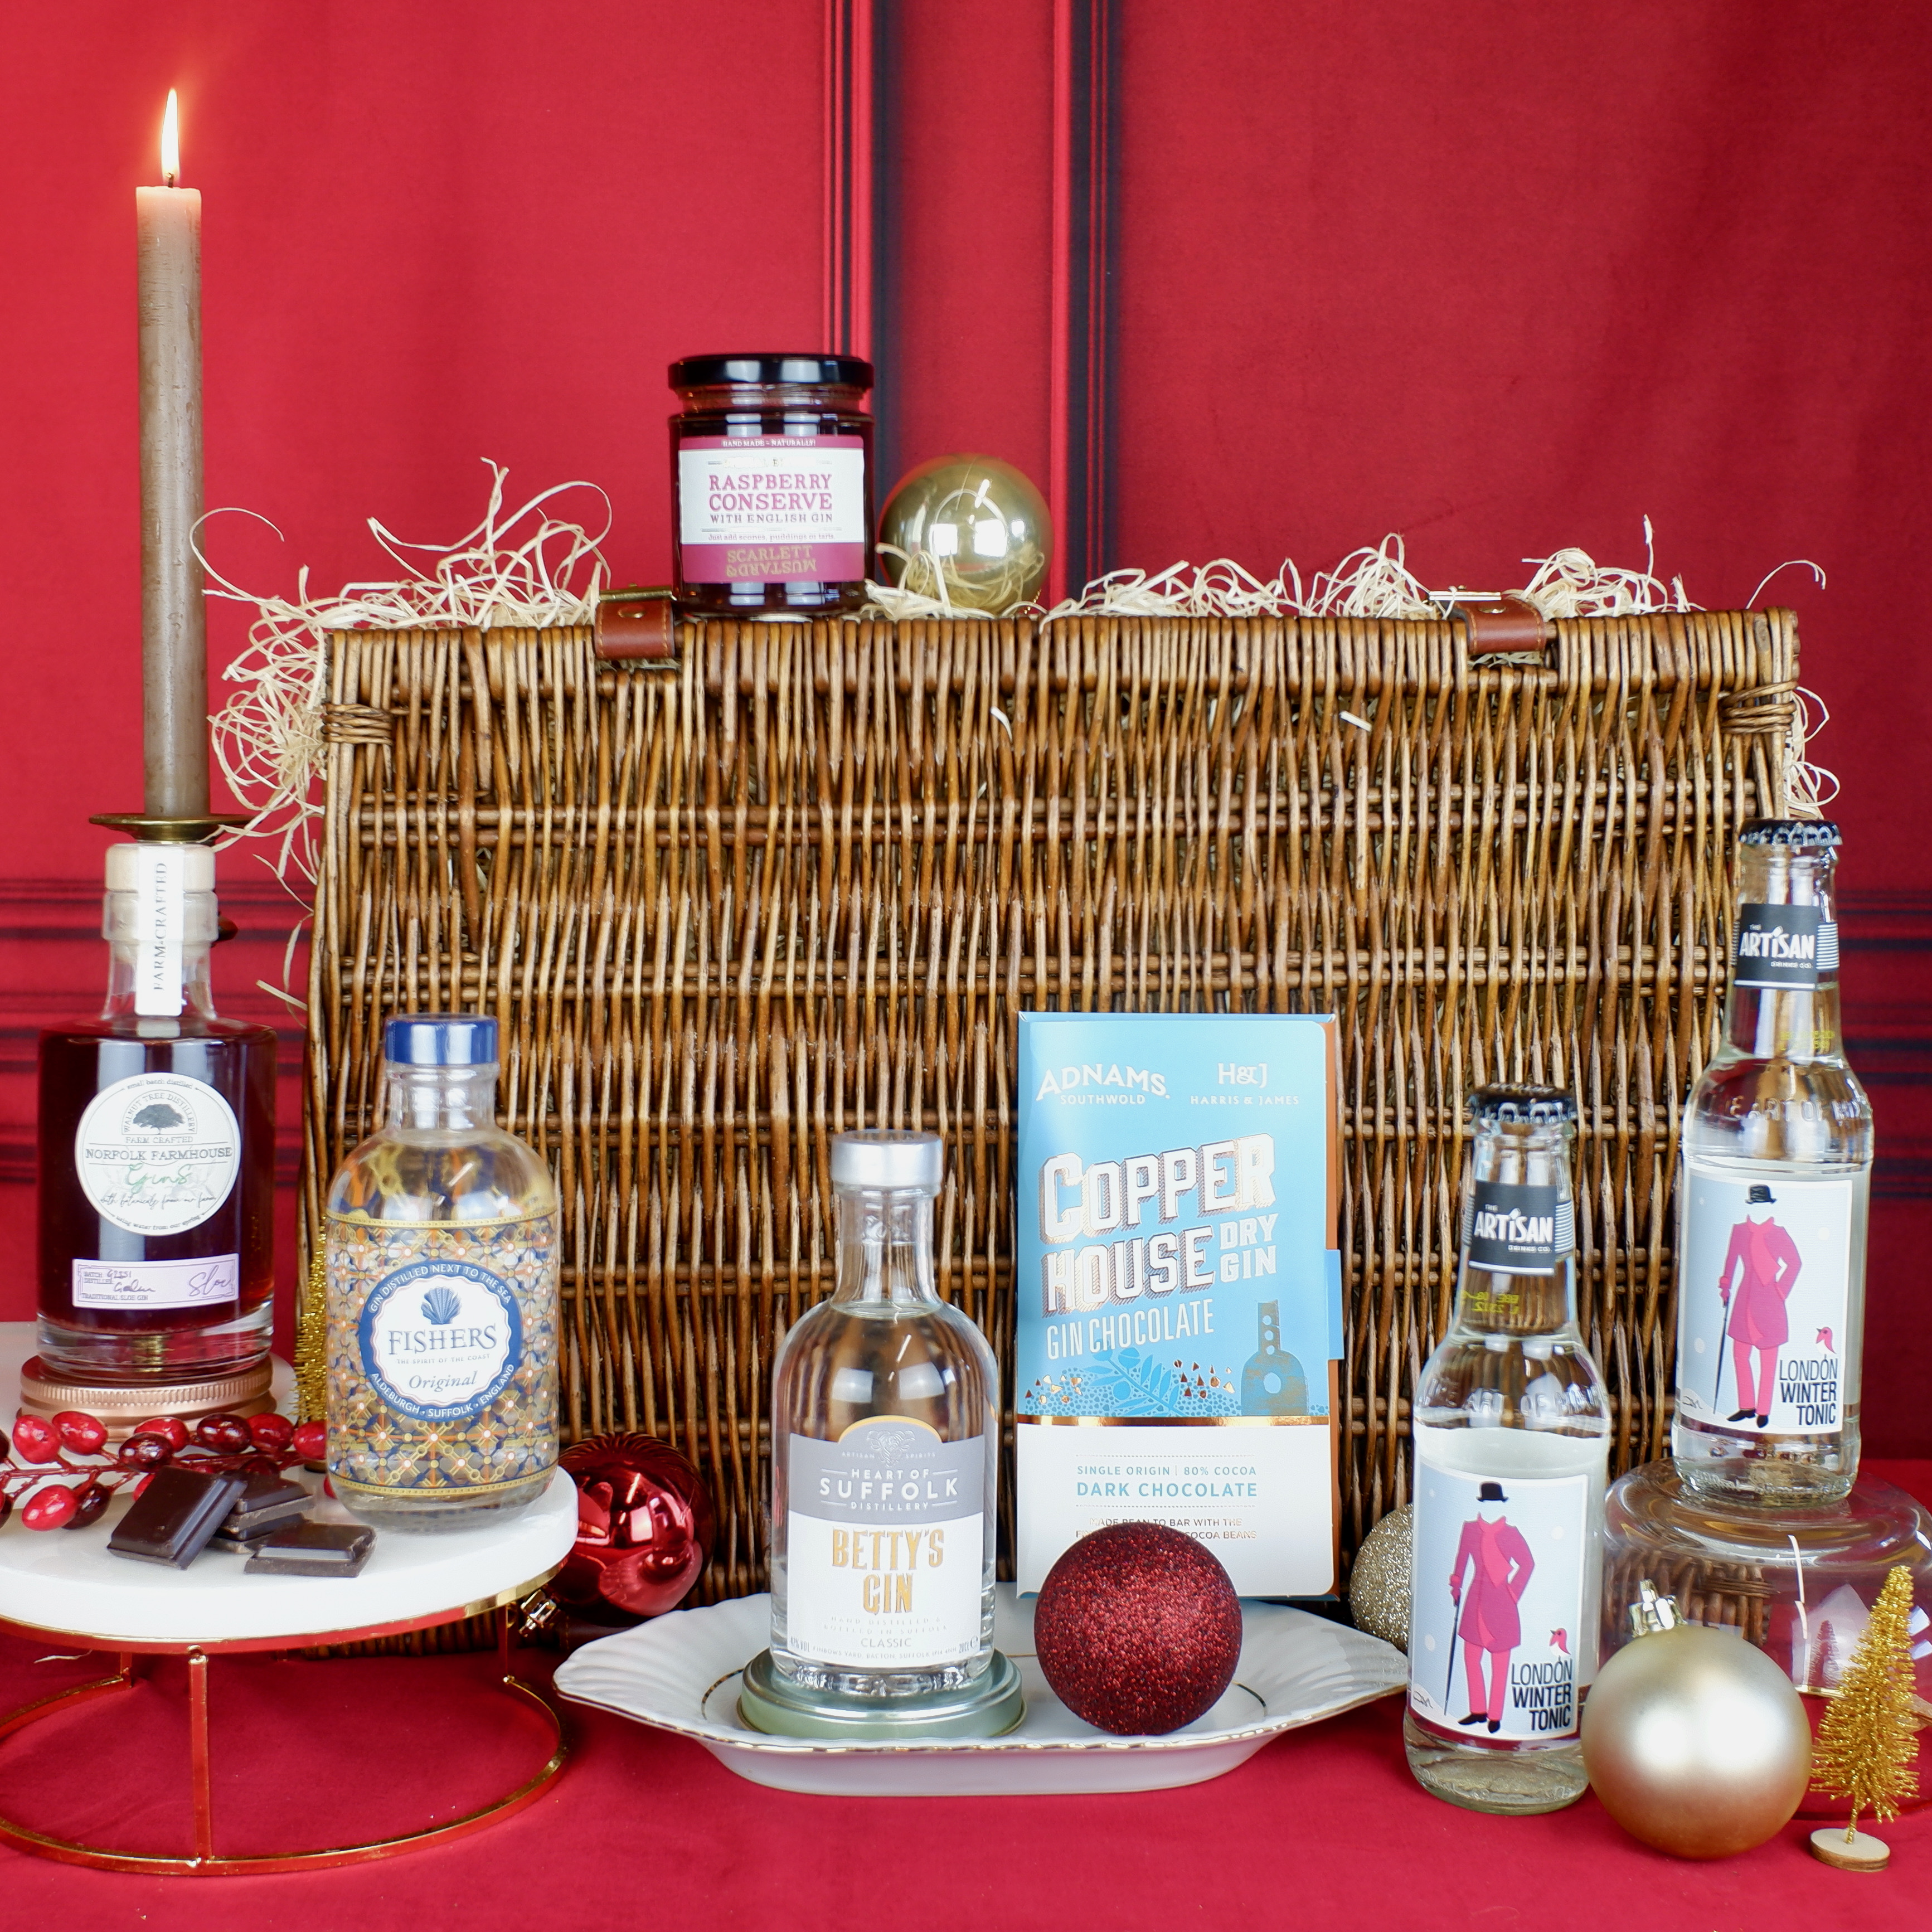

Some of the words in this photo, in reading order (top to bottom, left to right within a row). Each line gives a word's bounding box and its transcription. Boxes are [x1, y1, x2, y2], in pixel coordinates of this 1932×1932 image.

[744, 439, 765, 447] MADE
[709, 474, 832, 491] RASPBERRY
[709, 493, 833, 511] CONSERVE
[710, 513, 742, 523] WITH
[747, 513, 807, 523] ENGLISH
[811, 513, 833, 523] GIN
[770, 533, 807, 542] puddings
[727, 545, 813, 563] SCARLETT
[1217, 1062, 1268, 1088] H&J
[1060, 1094, 1145, 1104] SOUTHWOLD
[1191, 1095, 1240, 1105] HARRIS
[1244, 1096, 1253, 1104] &
[1258, 1095, 1299, 1105] JAMES
[124, 1099, 142, 1132] WALNUT
[142, 1093, 166, 1103] TREE
[167, 1093, 195, 1132] DISTILLERY
[86, 1149, 147, 1161] NORFOLK
[151, 1147, 233, 1160] FARMHOUSE
[1039, 1133, 1276, 1245] COPPER
[1219, 1213, 1279, 1250] DRY
[1040, 1225, 1216, 1318] HOUSE
[1220, 1245, 1277, 1283] GIN
[370, 1294, 384, 1313] GIN
[382, 1266, 429, 1295] DISTILLED
[432, 1263, 460, 1274] NEXT
[464, 1266, 479, 1278] TO
[481, 1271, 499, 1288] THE
[497, 1285, 512, 1304] SEA
[388, 1323, 498, 1355] FISHERS
[1046, 1321, 1082, 1361] GIN
[1089, 1299, 1215, 1353] CHOCOLATE
[1779, 1358, 1838, 1381] LONDON
[371, 1372, 420, 1414] ALDEBURGH
[428, 1402, 474, 1418] SUFFOLK
[479, 1363, 515, 1405] ENGLAND
[409, 1370, 478, 1392] Original
[1780, 1381, 1837, 1403] WINTER
[1796, 1403, 1837, 1425] TONIC
[852, 1468, 902, 1480] HEART
[910, 1468, 930, 1479] OF
[1077, 1466, 1121, 1475] SINGLE
[1127, 1466, 1170, 1476] ORIGIN
[1184, 1467, 1208, 1476] 80%
[1214, 1467, 1257, 1476] COCOA
[820, 1477, 958, 1501] SUFFOLK
[1077, 1483, 1130, 1497] DARK
[1138, 1483, 1258, 1497] CHOCOLATE
[851, 1501, 929, 1512] DISTILLERY
[1222, 1518, 1243, 1526] THE
[1224, 1531, 1258, 1540] BEANS
[832, 1527, 945, 1571] BETTY'S
[863, 1572, 914, 1615] GIN
[813, 1645, 842, 1656] FINBOWS
[861, 1638, 912, 1648] CLASSIC
[1511, 1658, 1573, 1686] LONDON
[1512, 1682, 1572, 1708] WINTER
[1528, 1706, 1572, 1731] TONIC
